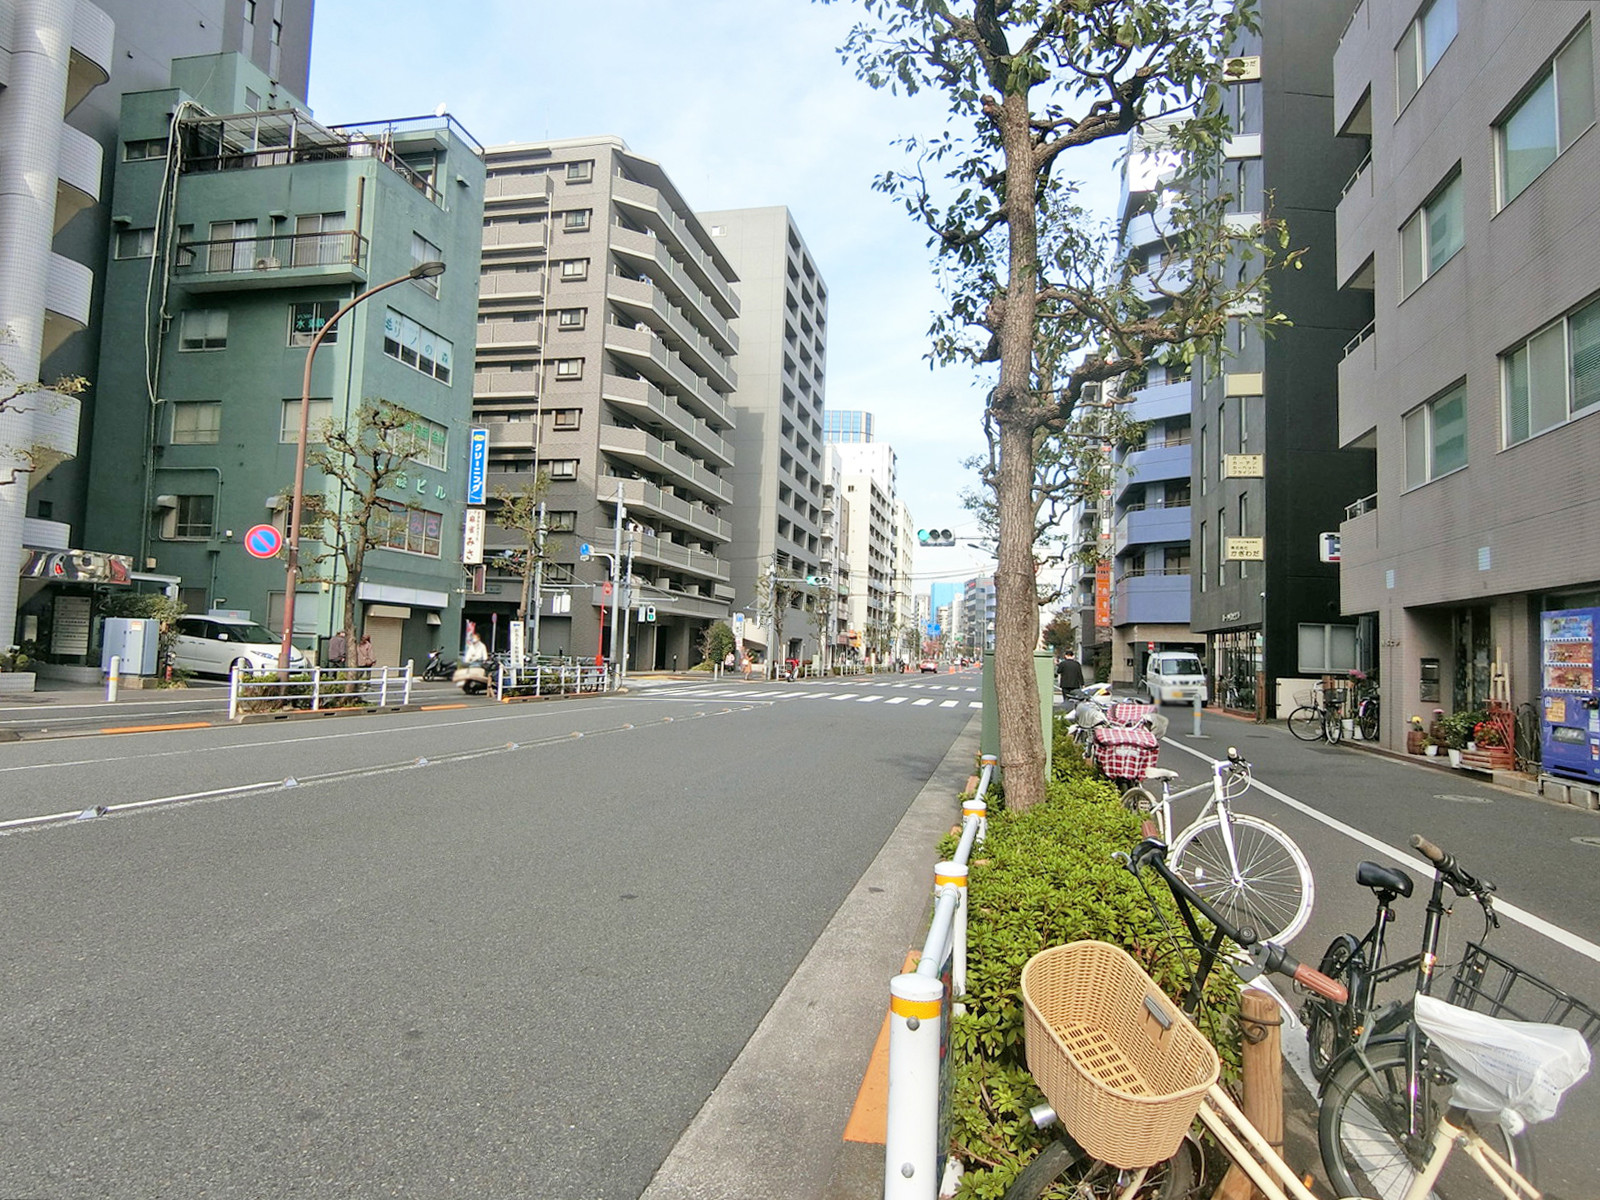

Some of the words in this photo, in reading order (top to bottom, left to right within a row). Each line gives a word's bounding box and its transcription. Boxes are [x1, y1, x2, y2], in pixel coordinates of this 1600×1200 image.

[471, 443, 483, 494] クリーニング
